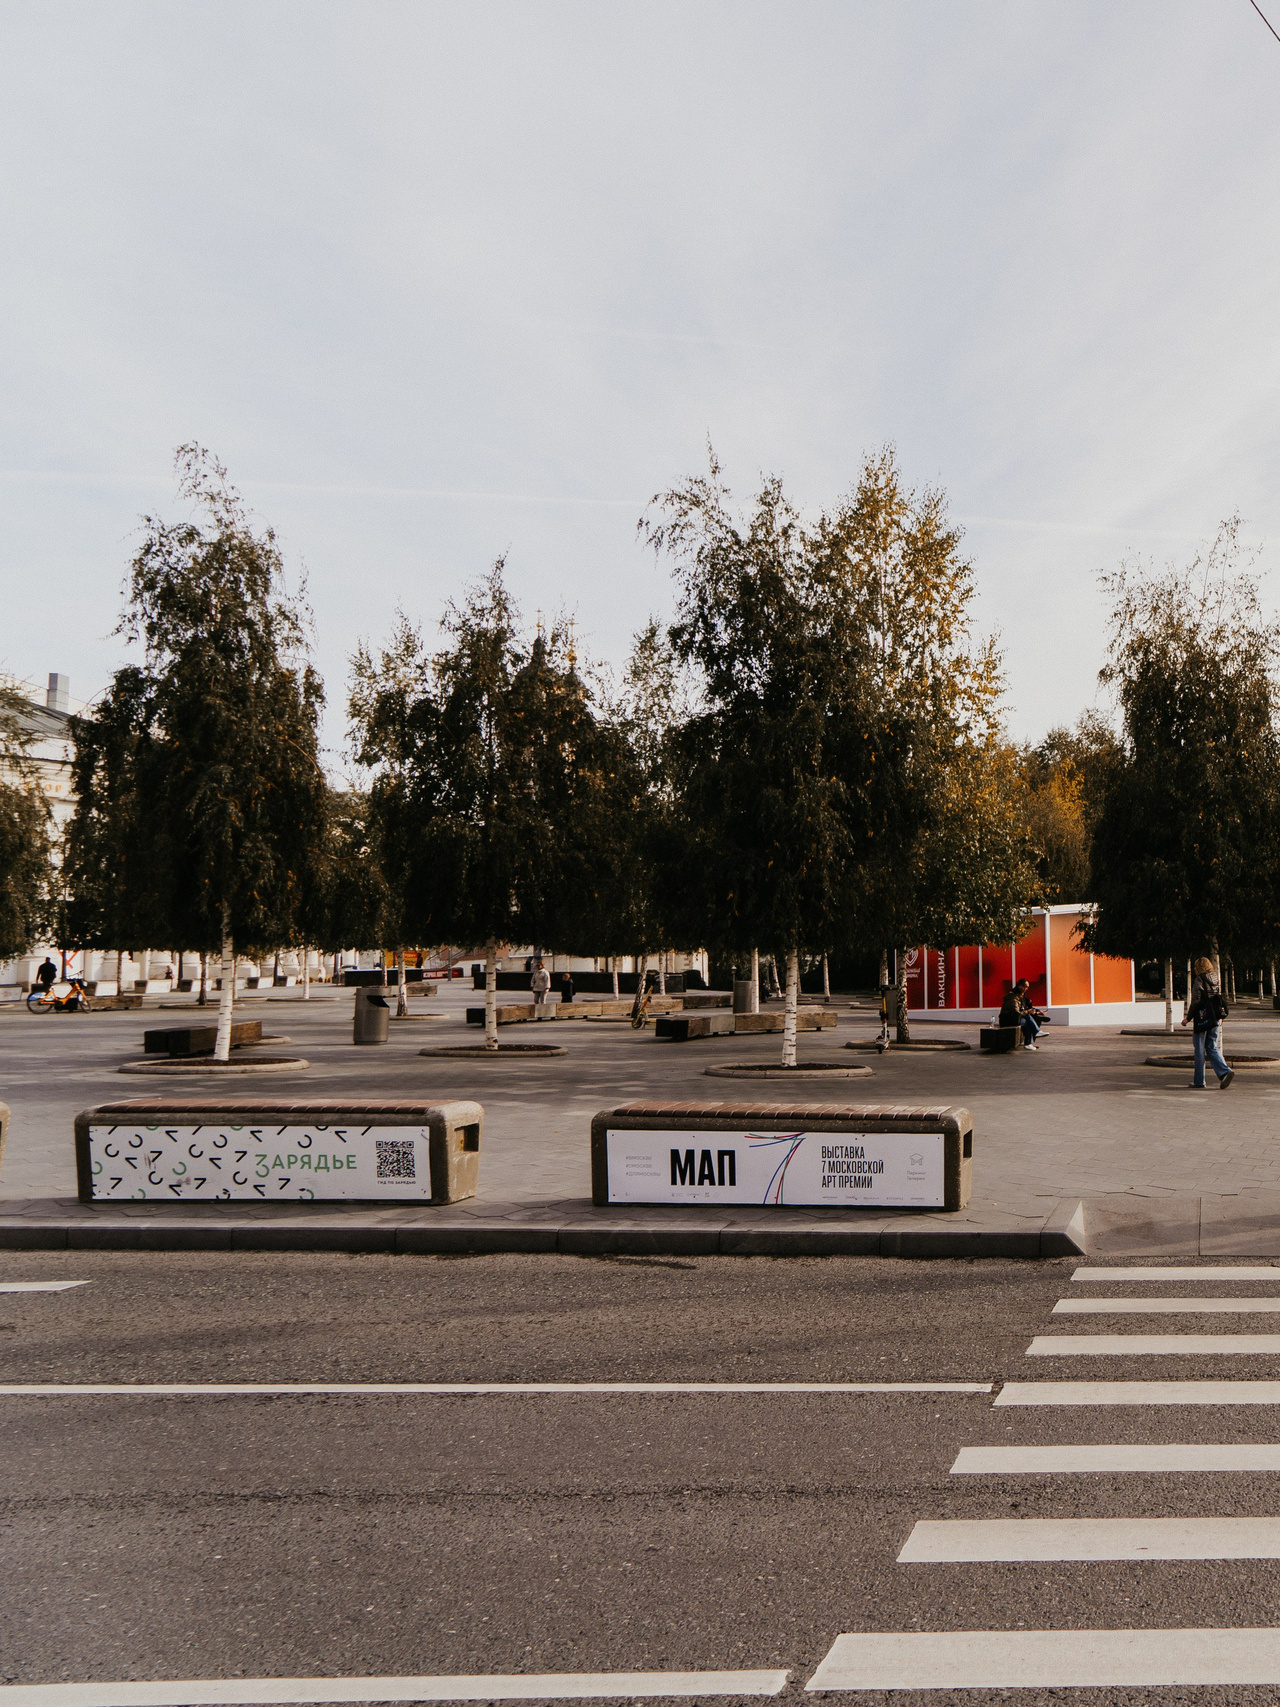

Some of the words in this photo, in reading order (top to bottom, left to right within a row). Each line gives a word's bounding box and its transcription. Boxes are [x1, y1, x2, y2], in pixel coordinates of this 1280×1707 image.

[821, 1146, 865, 1159] ВЫСТАВКА
[255, 1154, 357, 1178] ЗАРЯДЬЕ
[670, 1149, 736, 1186] МАП
[821, 1161, 826, 1174] 7
[828, 1160, 884, 1174] МОСКОВСКОЙ
[821, 1175, 837, 1188] АРТ
[838, 1175, 873, 1188] ПРЕМИИ
